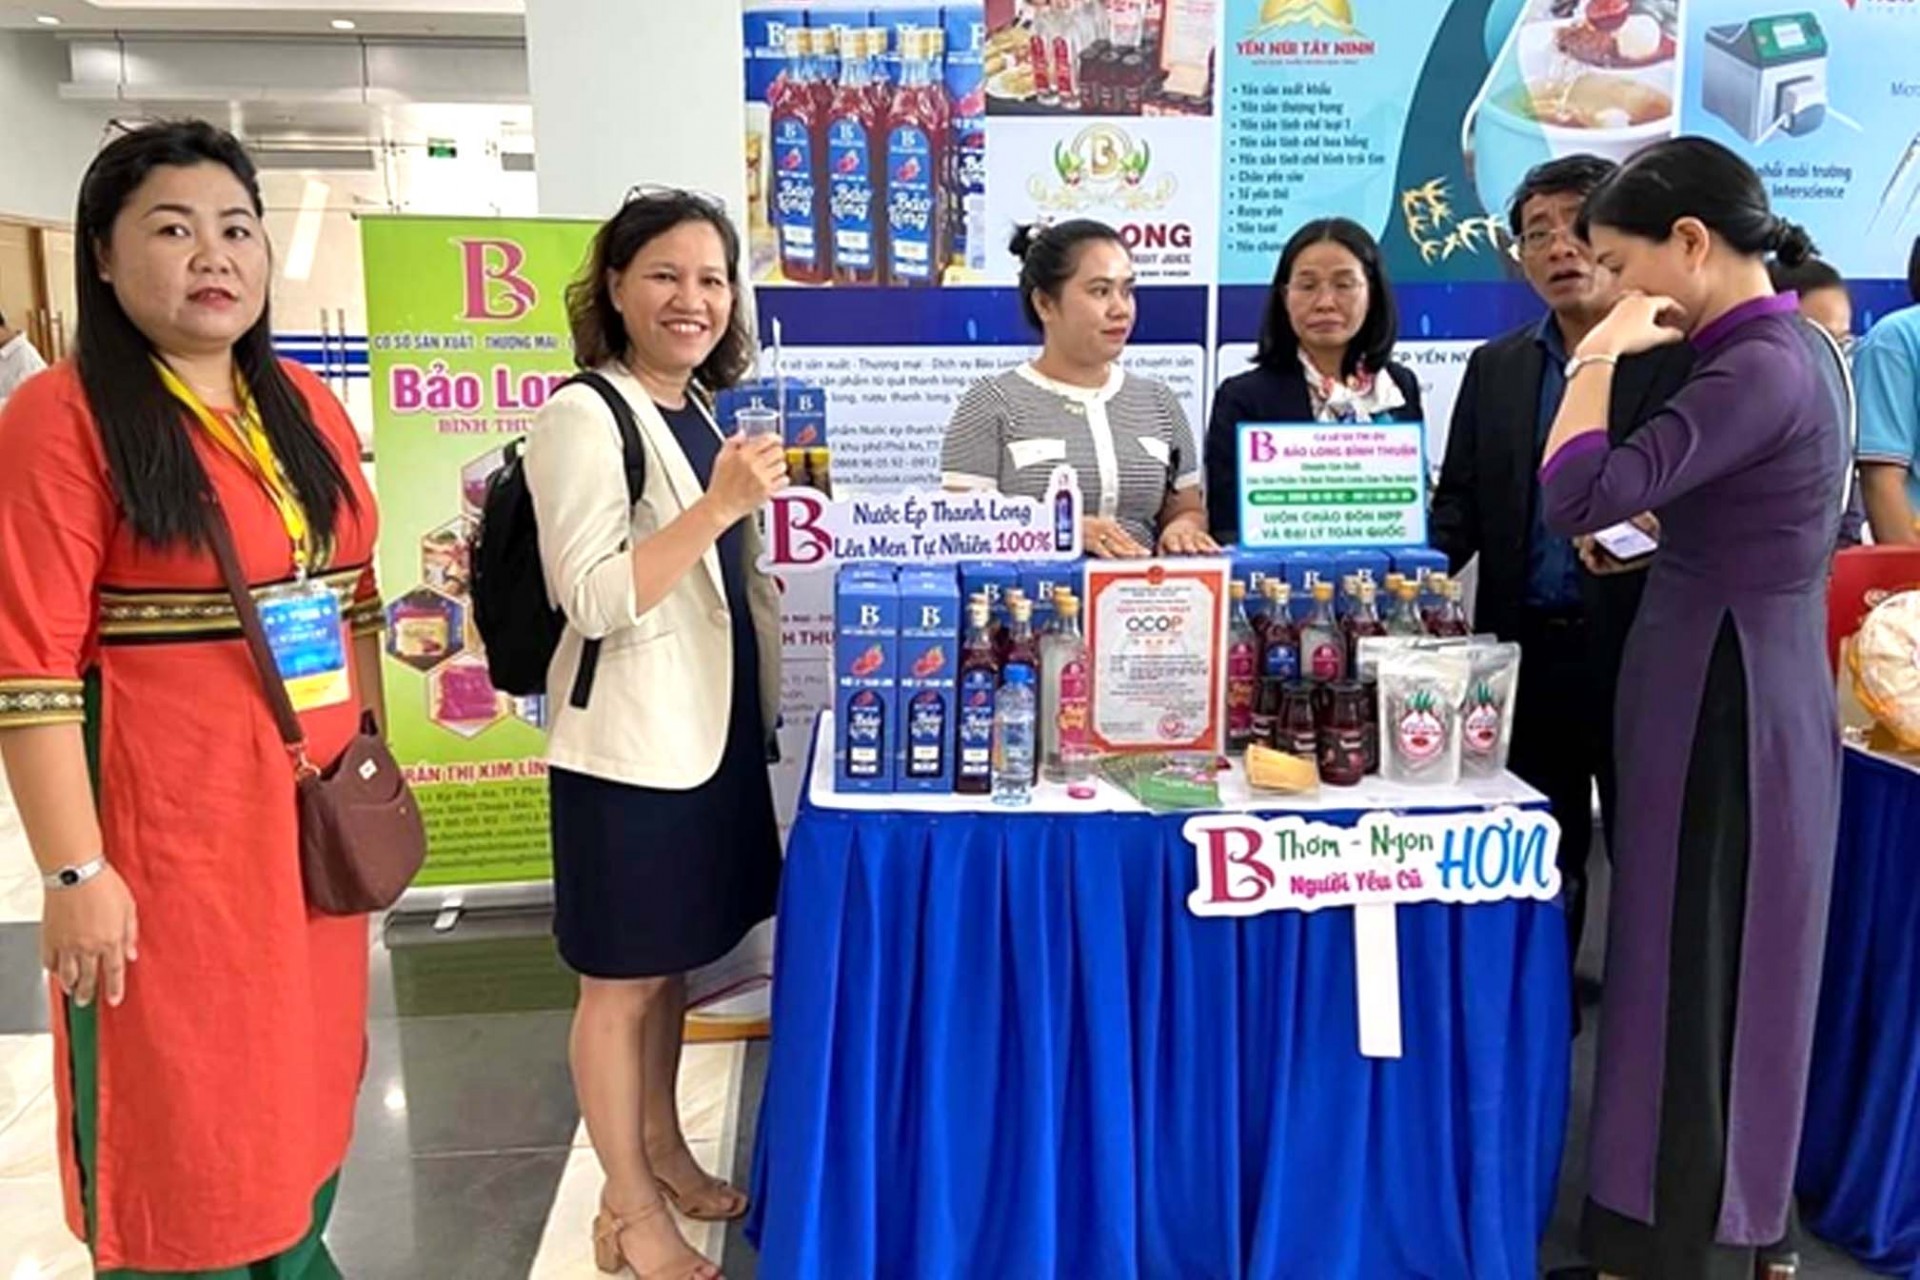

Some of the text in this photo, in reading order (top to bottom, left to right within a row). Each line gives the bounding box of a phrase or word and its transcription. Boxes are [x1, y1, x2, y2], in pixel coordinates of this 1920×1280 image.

[1236, 38, 1375, 55] YẾN NÚI TÂY NINH
[1118, 222, 1192, 249] ONG
[455, 238, 537, 321] B
[393, 362, 481, 410] Bảo
[496, 417, 534, 433] THU
[1249, 430, 1278, 463] B
[1283, 443, 1418, 458] BẢO LONG BÌNH THUẬN
[853, 496, 1031, 529] Nước Ép Thanh Long
[1264, 508, 1404, 524] LUÔN CHÀO ĐÓN NPP
[771, 496, 832, 565] B
[1262, 525, 1280, 540] VÀ
[1309, 524, 1324, 539] LÝ
[1328, 523, 1364, 539] TOÀN
[1366, 522, 1407, 539] QUỐC
[833, 531, 1053, 560] Lên Men Tự Nhiên 100%
[860, 604, 881, 628] B
[921, 605, 942, 629] B
[1125, 614, 1184, 633] OCOP
[800, 630, 835, 646] THU
[404, 762, 440, 783] RẦN
[479, 761, 513, 779] KIM
[518, 759, 549, 776] LIN
[1275, 827, 1341, 862] Thơm
[1370, 823, 1434, 864] Ngon
[1436, 816, 1551, 890] HƠN
[1196, 824, 1275, 904] B
[1290, 868, 1424, 899] Người Yêu Cũ
